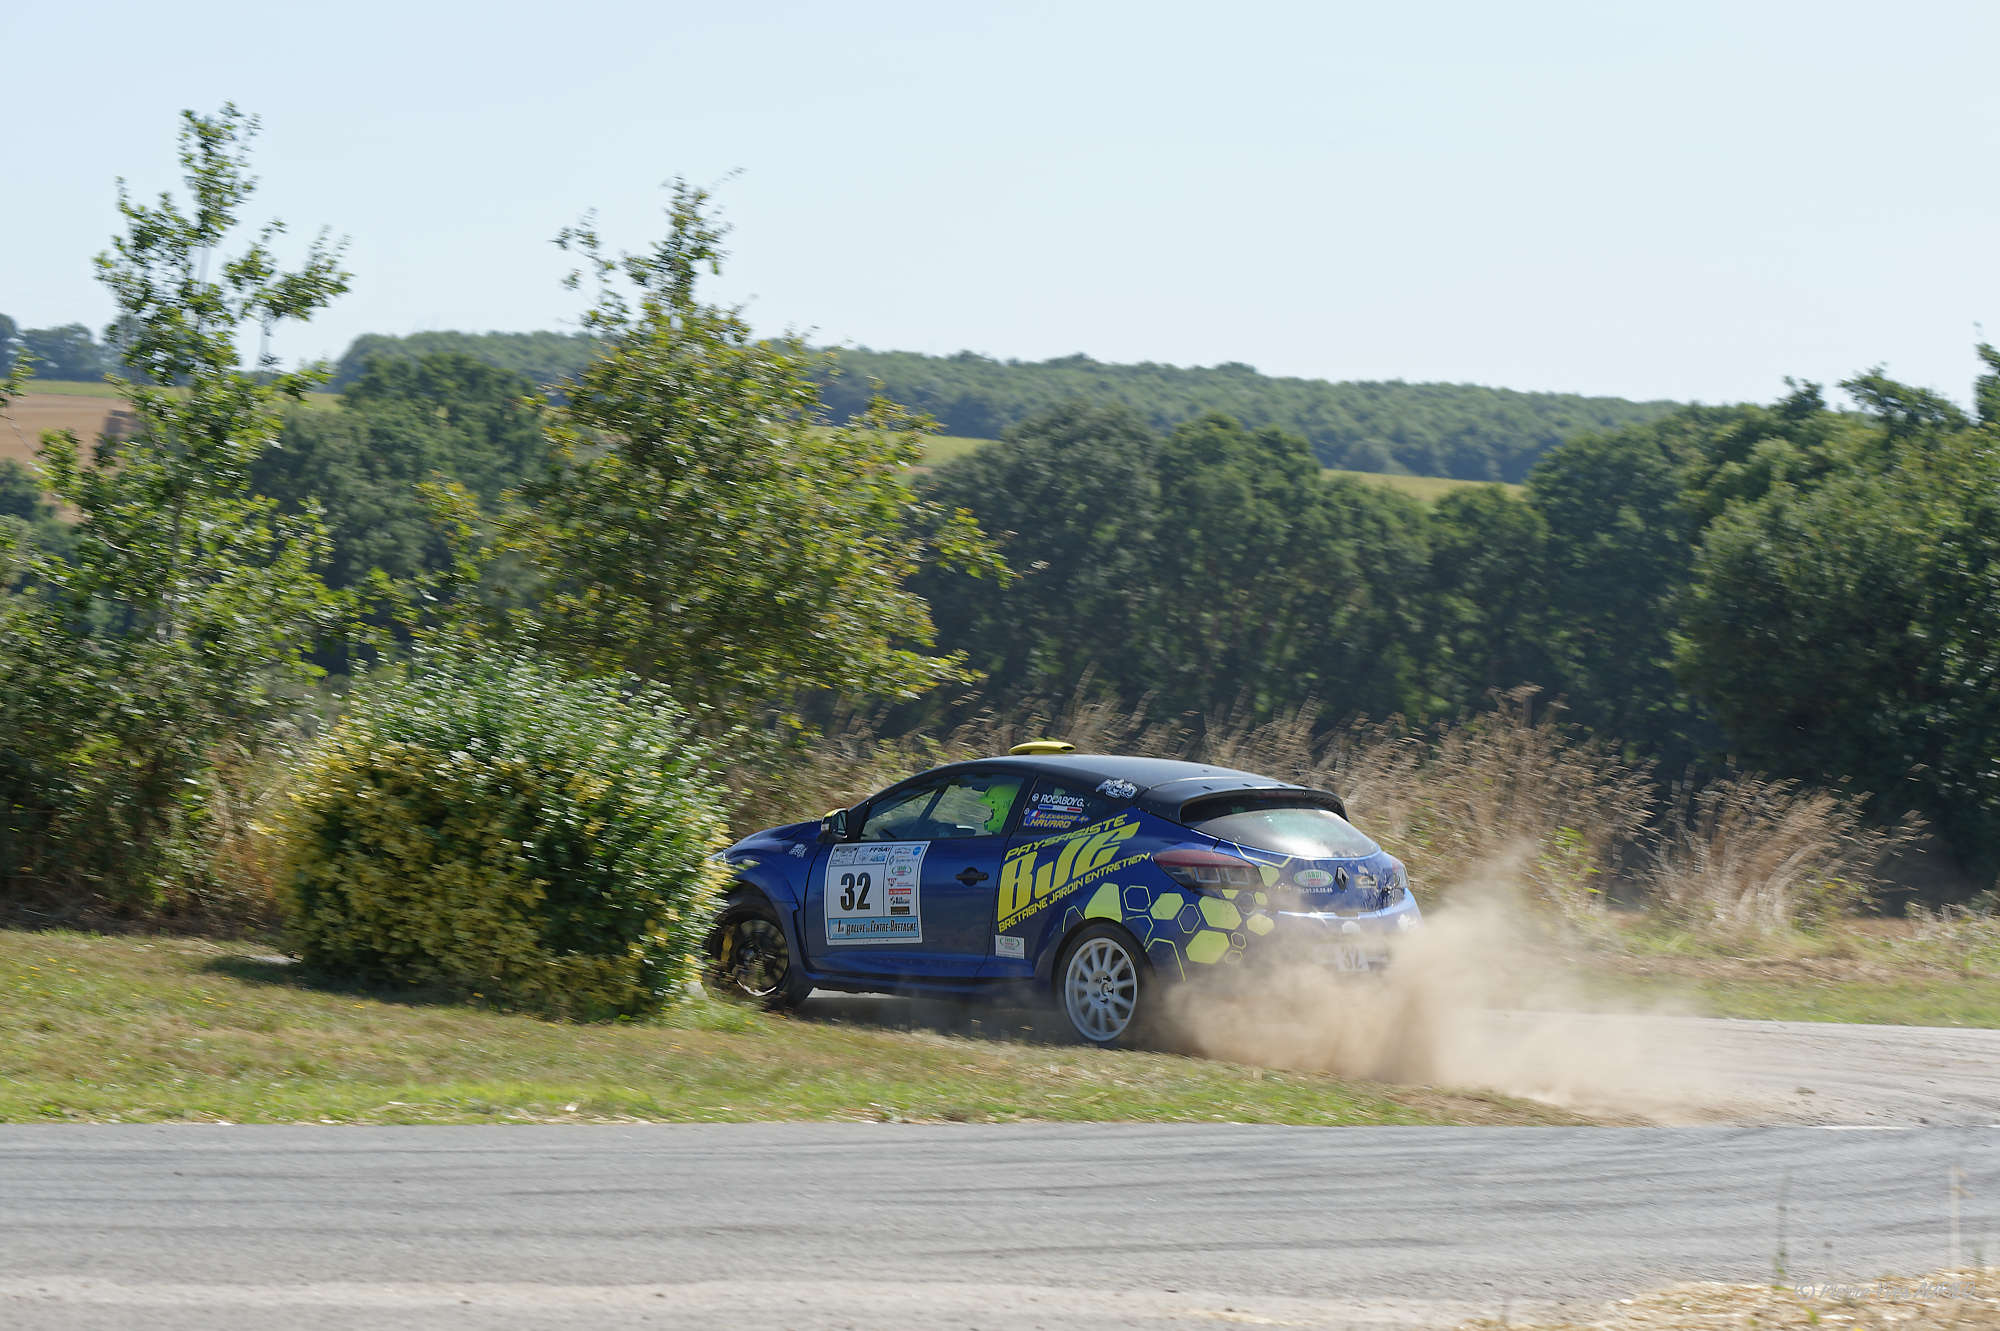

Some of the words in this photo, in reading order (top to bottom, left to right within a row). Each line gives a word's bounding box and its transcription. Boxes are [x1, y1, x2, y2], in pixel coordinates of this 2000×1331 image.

[1005, 813, 1128, 861] PAYSAGISTE
[1030, 818, 1071, 829] HAVARD
[840, 872, 871, 911] 32
[998, 898, 1048, 933] BRETAGNE
[1049, 880, 1084, 905] JARDIN
[1084, 852, 1151, 884] ENTRETIEN
